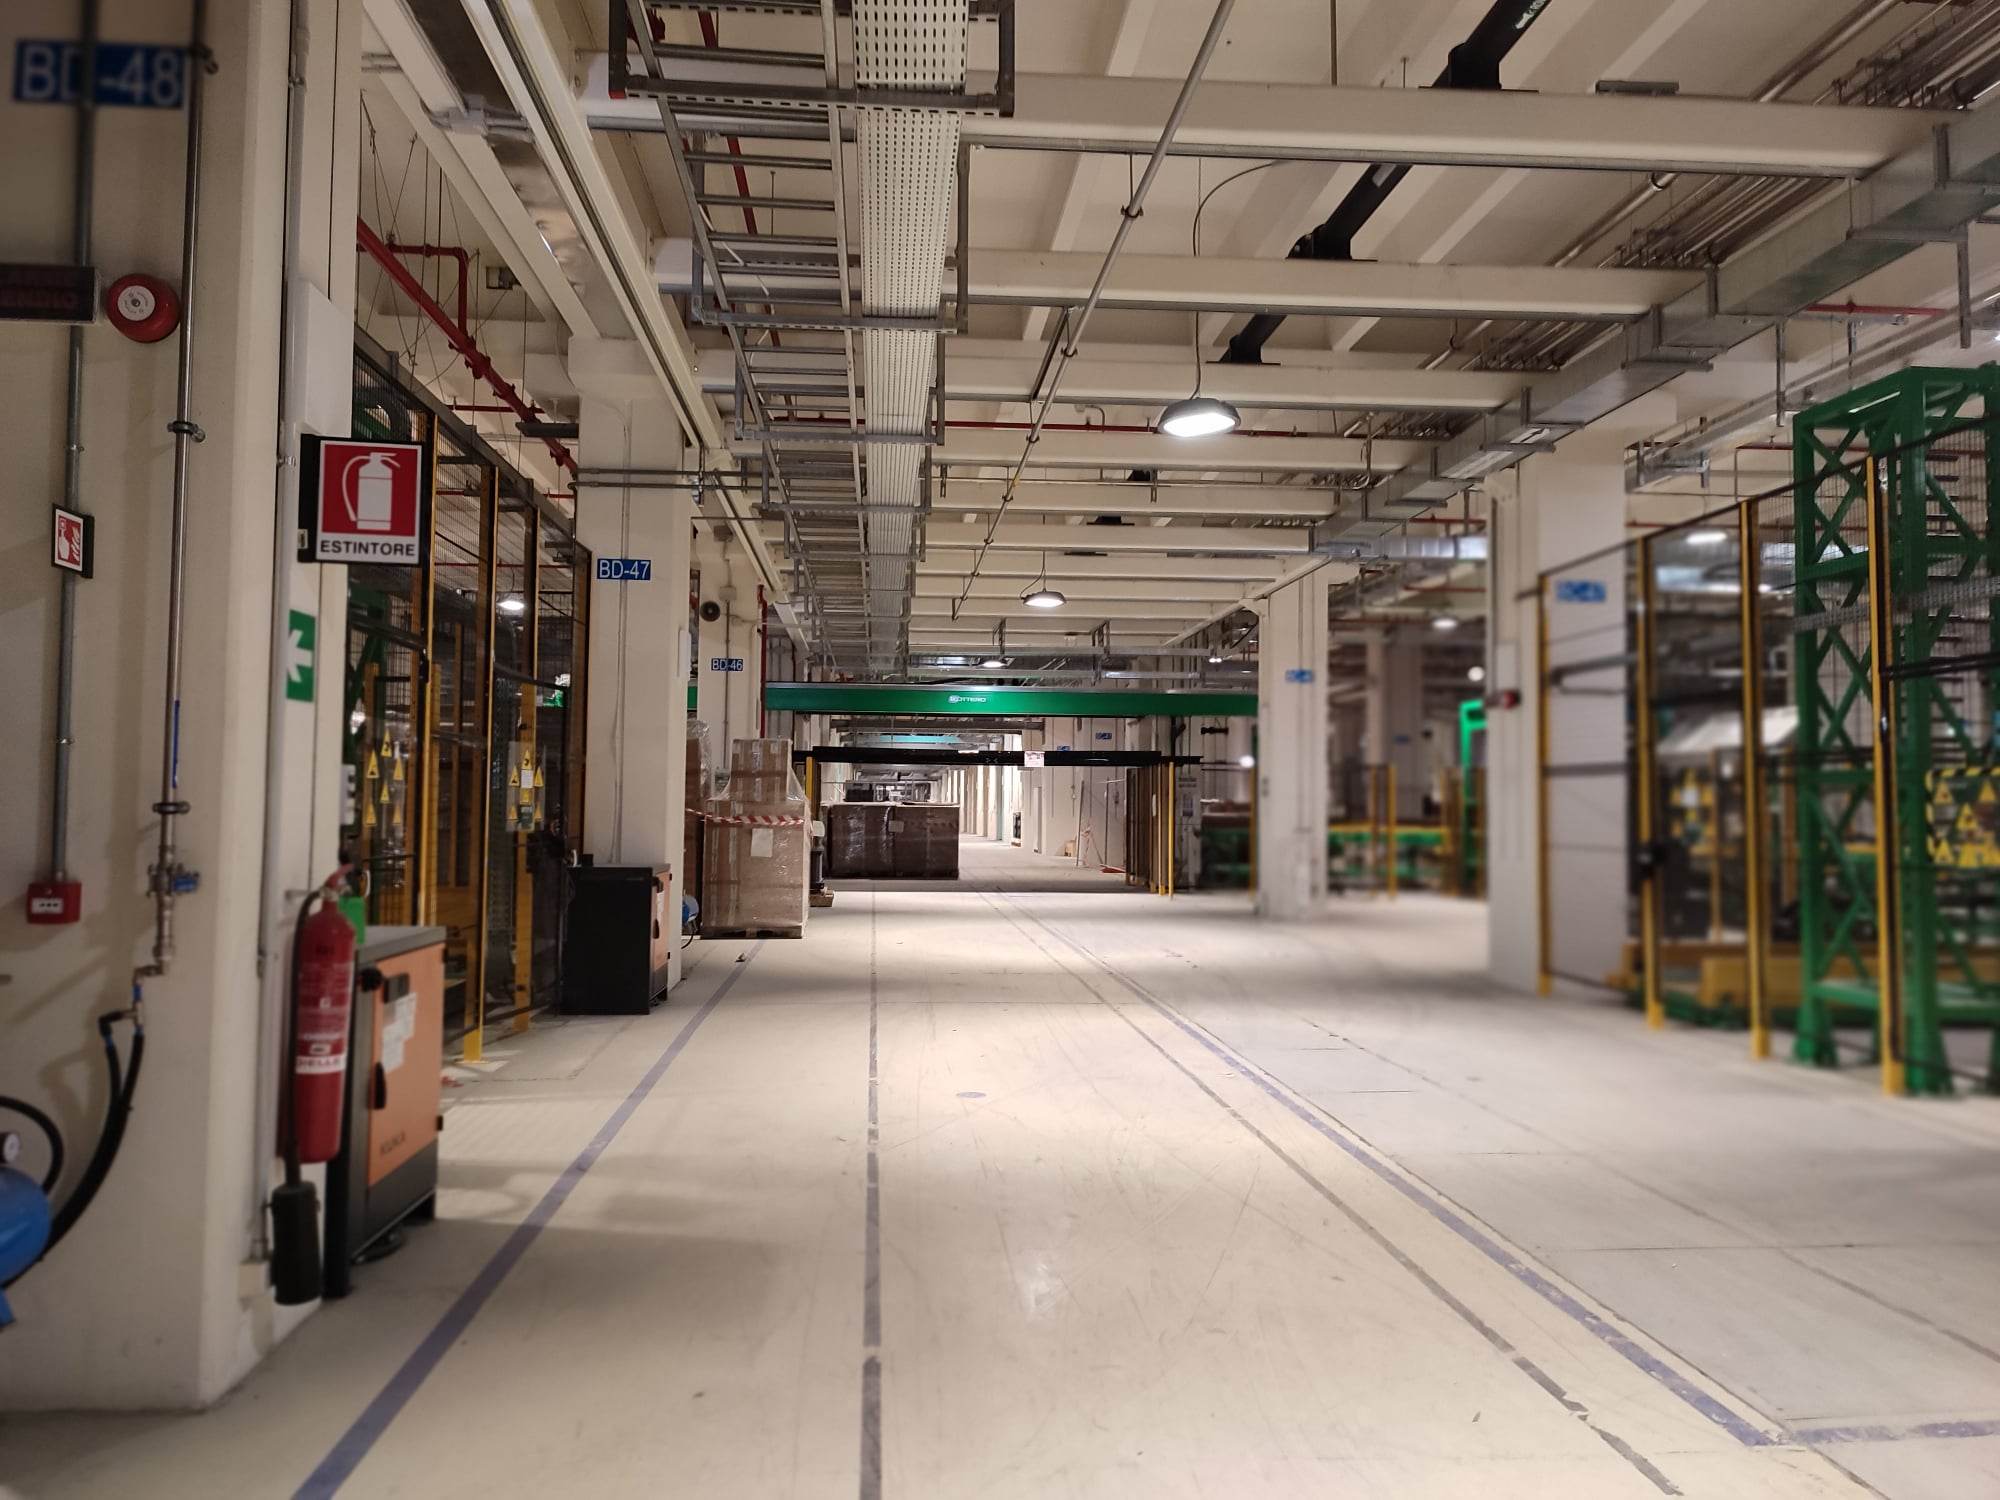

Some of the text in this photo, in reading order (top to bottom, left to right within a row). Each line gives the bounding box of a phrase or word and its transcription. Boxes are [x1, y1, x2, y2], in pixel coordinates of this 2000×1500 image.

[320, 540, 415, 556] ESTINTORE
[599, 560, 650, 579] BD-47
[712, 659, 743, 670] BD-46
